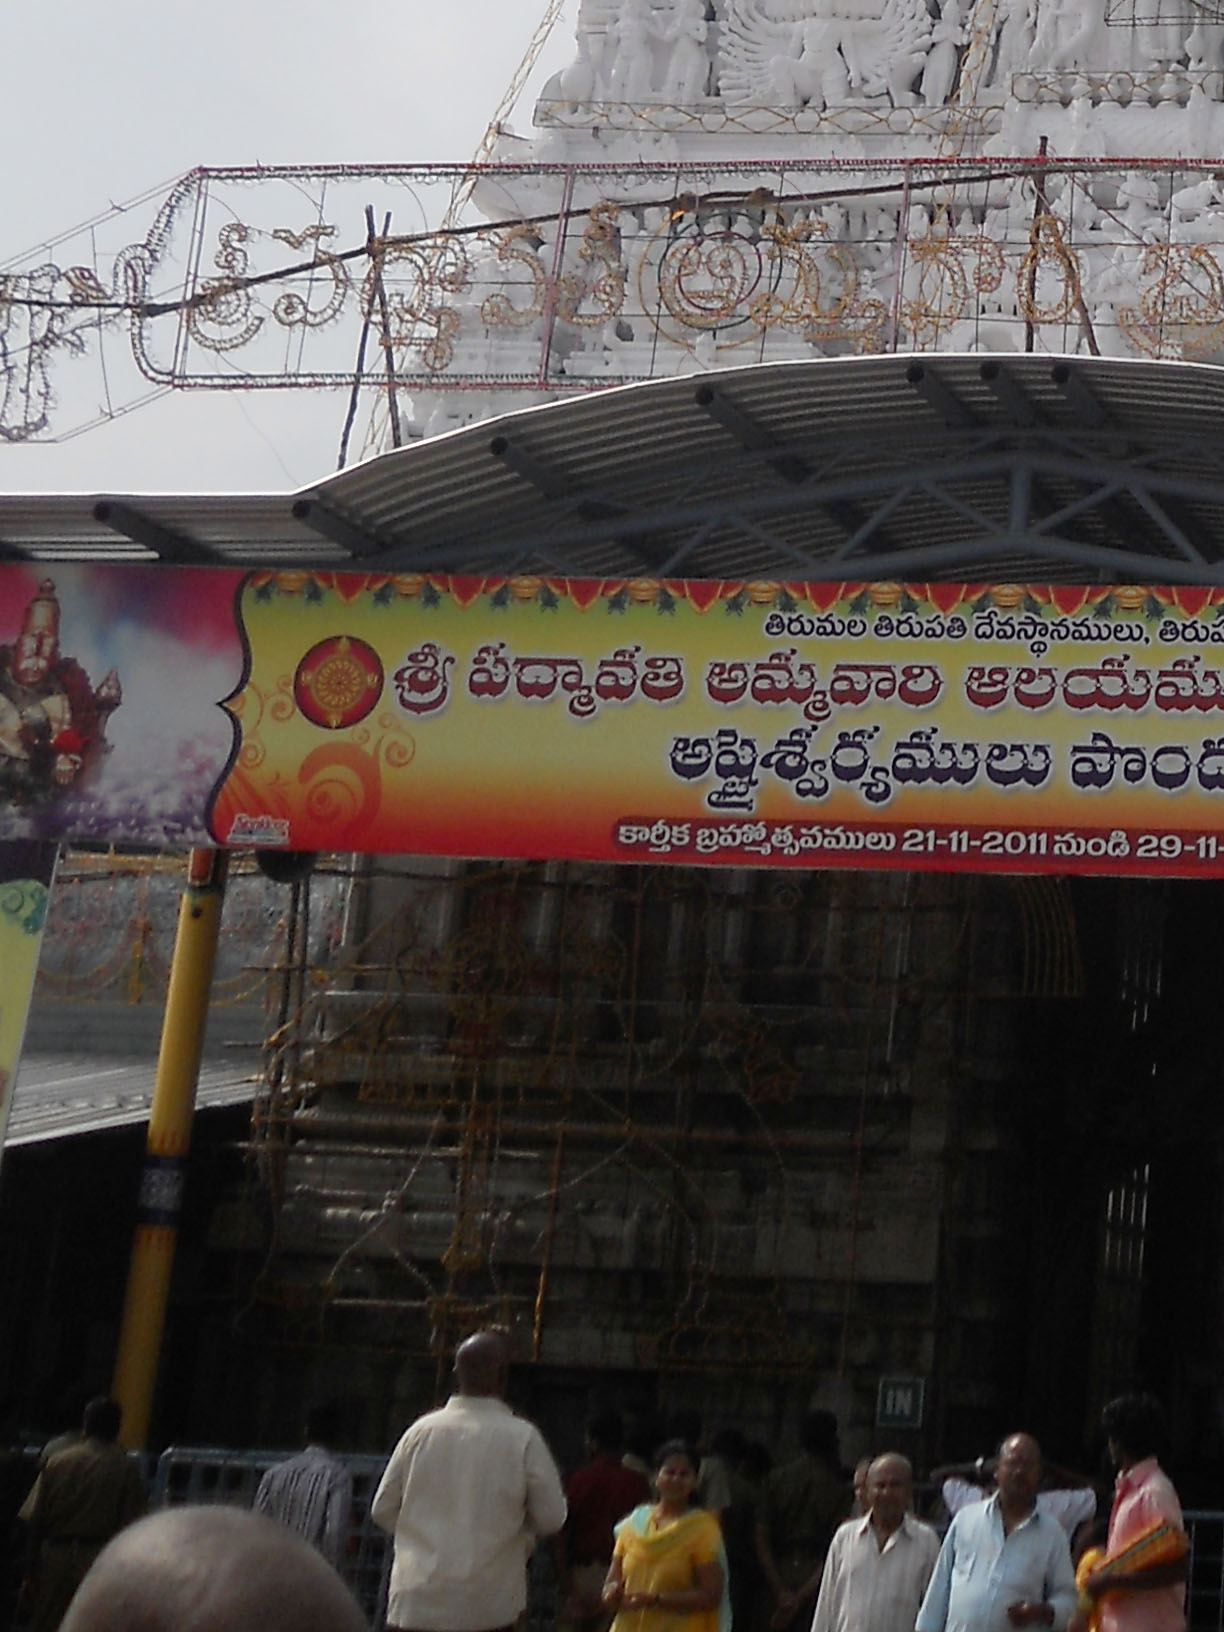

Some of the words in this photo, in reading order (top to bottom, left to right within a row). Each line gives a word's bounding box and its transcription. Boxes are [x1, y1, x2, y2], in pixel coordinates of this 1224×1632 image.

[765, 613, 868, 638] తిరుమల
[874, 615, 968, 640] తిరుపతి
[974, 610, 1151, 658] దేవస్థానములు,
[394, 643, 456, 715] శ్రీ
[468, 642, 685, 718] పద్మావతి
[706, 648, 945, 723] అమ్మవారి
[669, 725, 1052, 812] అష్టైశ్వర్యములు
[618, 820, 691, 853] కార్తీక
[696, 821, 897, 857] బ్రహ్మోత్సవములు
[902, 828, 1047, 856] 21-11-2011
[1053, 830, 1131, 858] నుండి
[886, 1389, 912, 1416] IN
